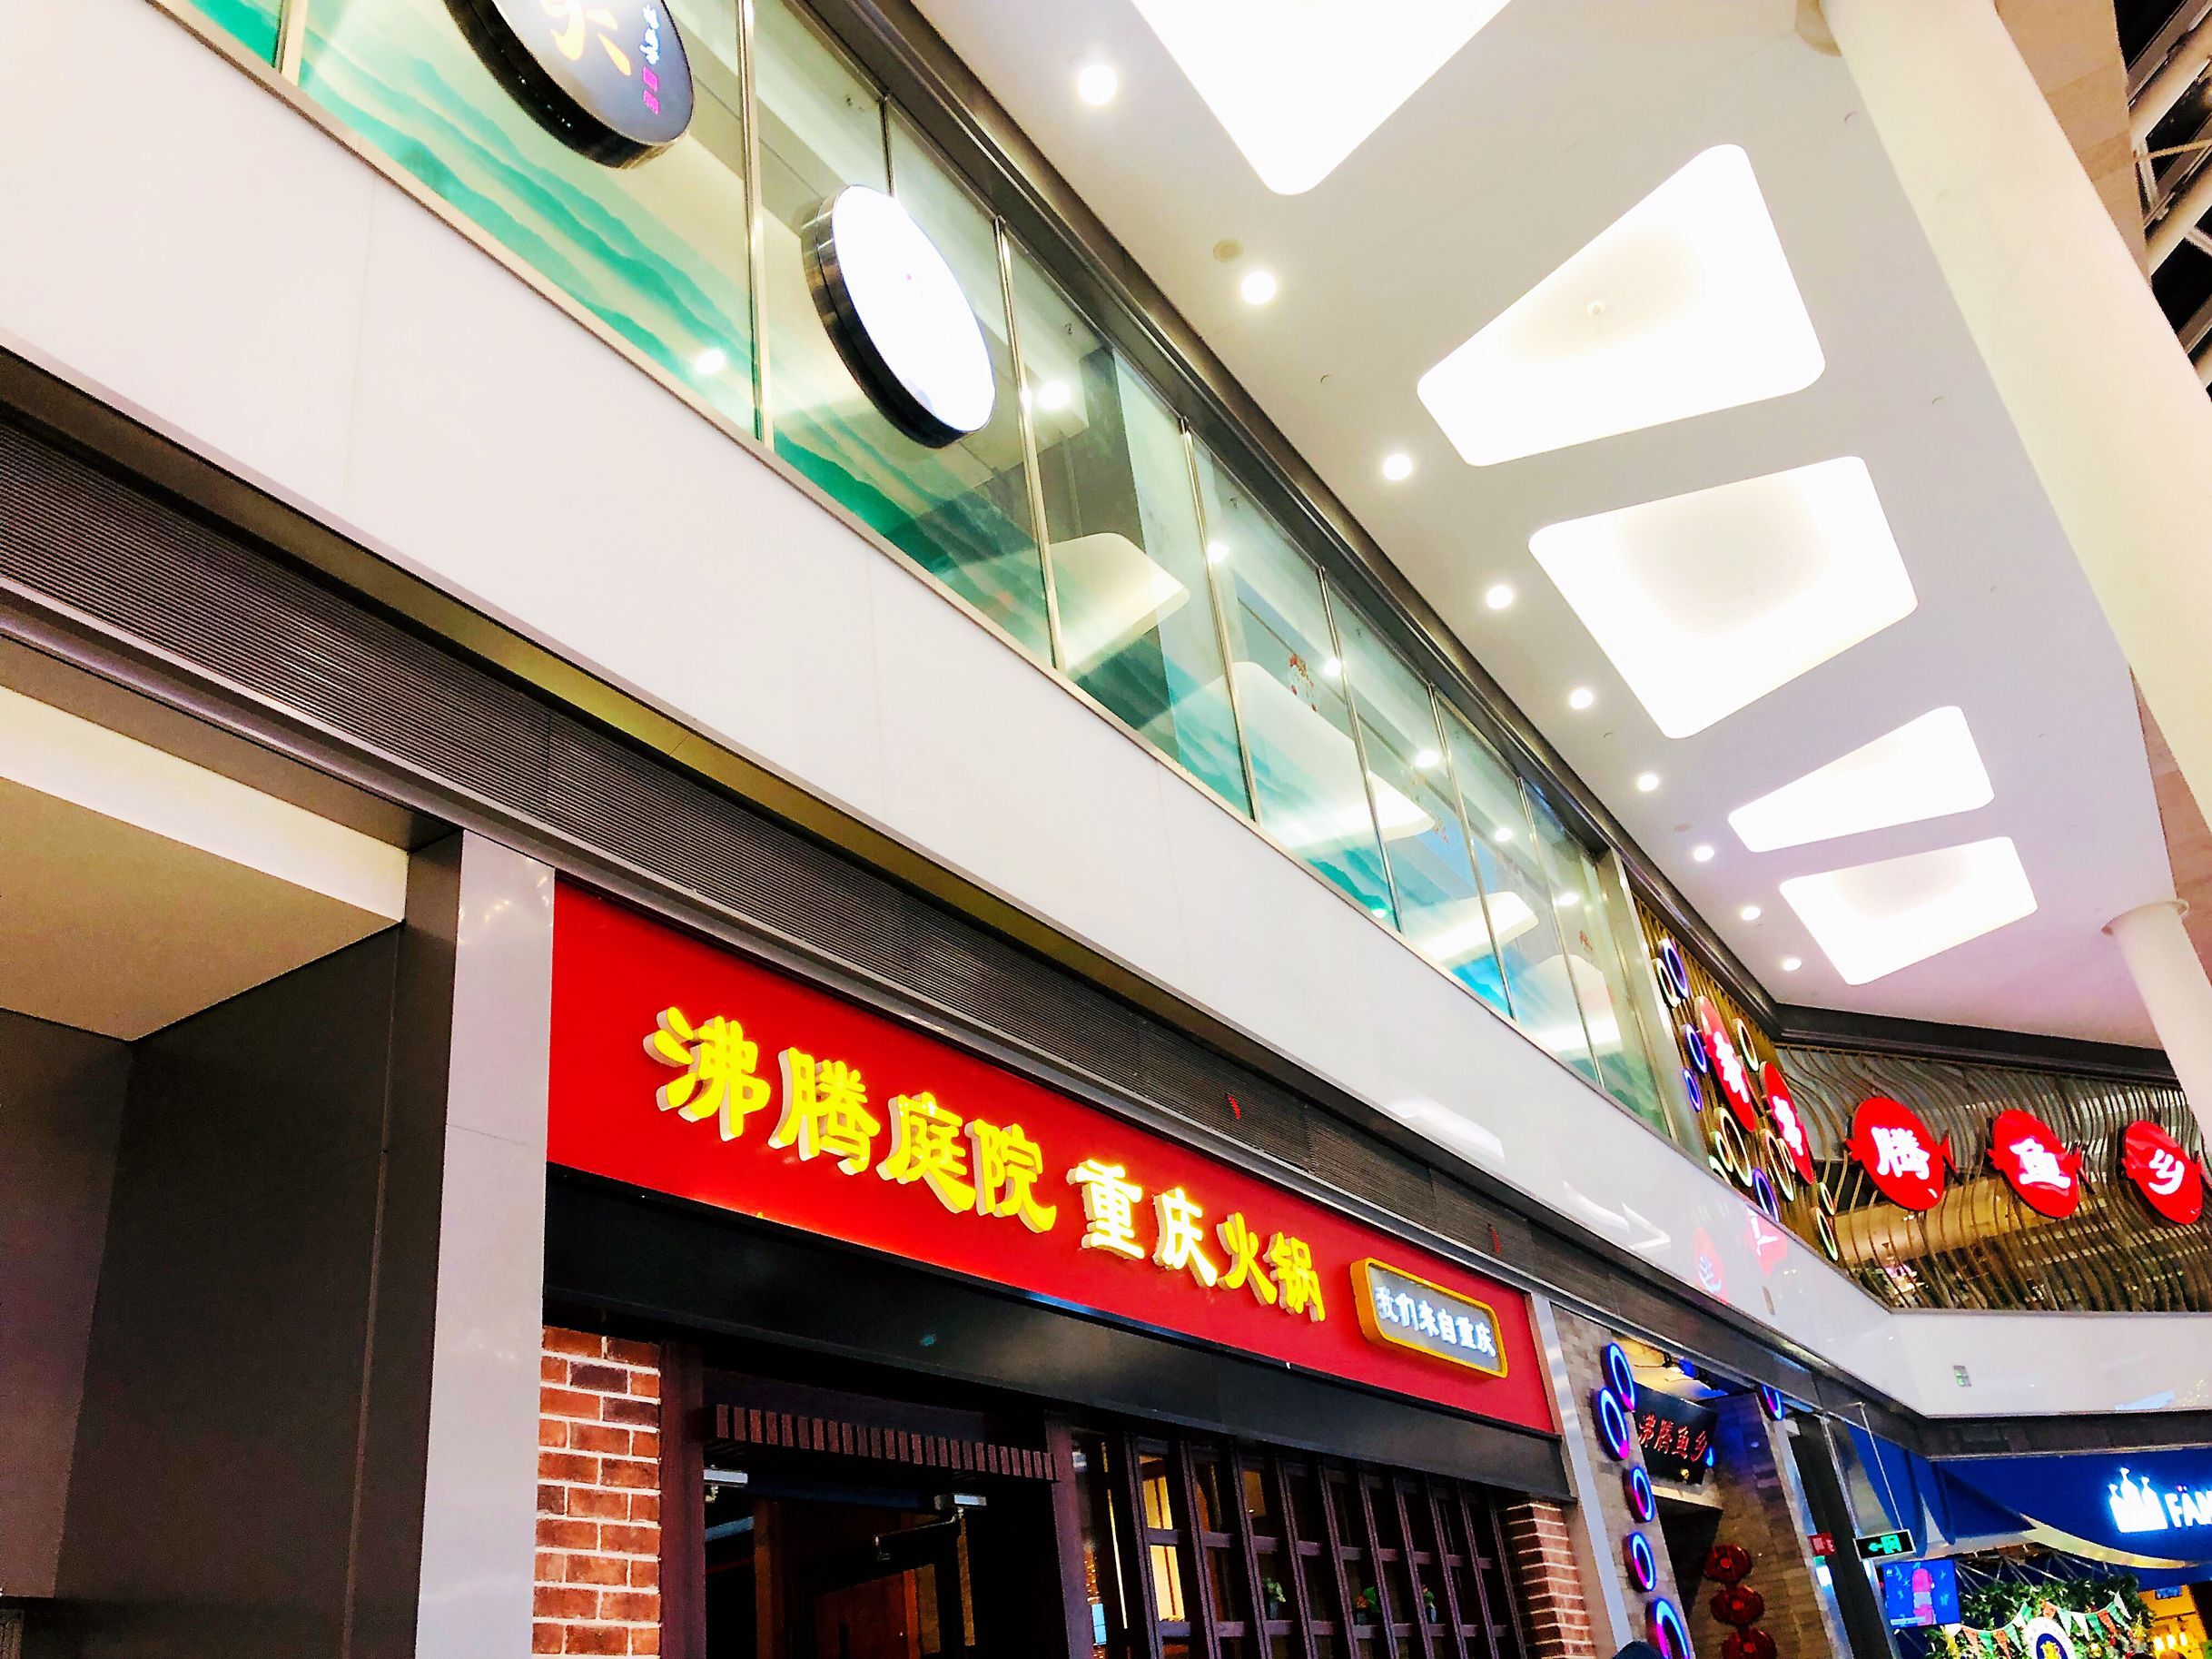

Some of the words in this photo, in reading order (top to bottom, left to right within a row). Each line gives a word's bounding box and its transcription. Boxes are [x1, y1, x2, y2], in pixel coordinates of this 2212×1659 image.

[643, 1007, 1057, 1233] 沸腾庭院
[1066, 1159, 1326, 1322] 重庆火锅
[1375, 1286, 1496, 1358] 我们来自重庆
